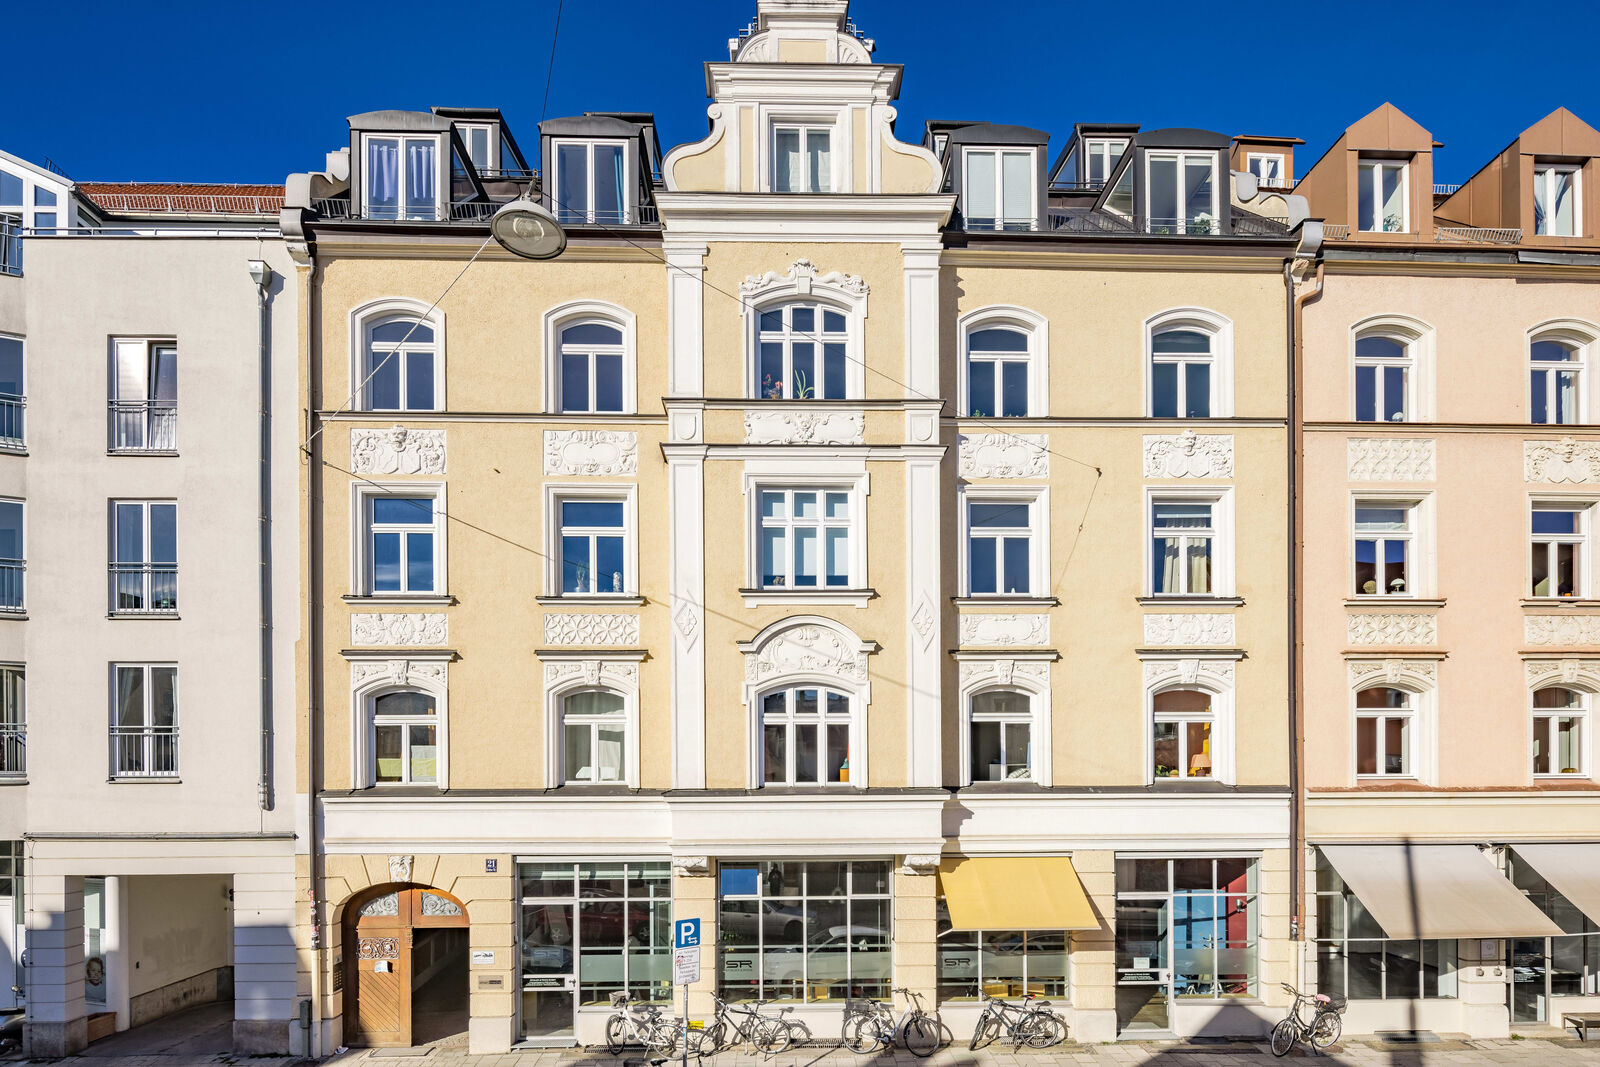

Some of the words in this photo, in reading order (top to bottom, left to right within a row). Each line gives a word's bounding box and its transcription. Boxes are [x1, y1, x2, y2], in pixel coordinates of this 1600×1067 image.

[681, 922, 695, 945] P
[726, 960, 753, 968] SR
[945, 958, 970, 966] SR
